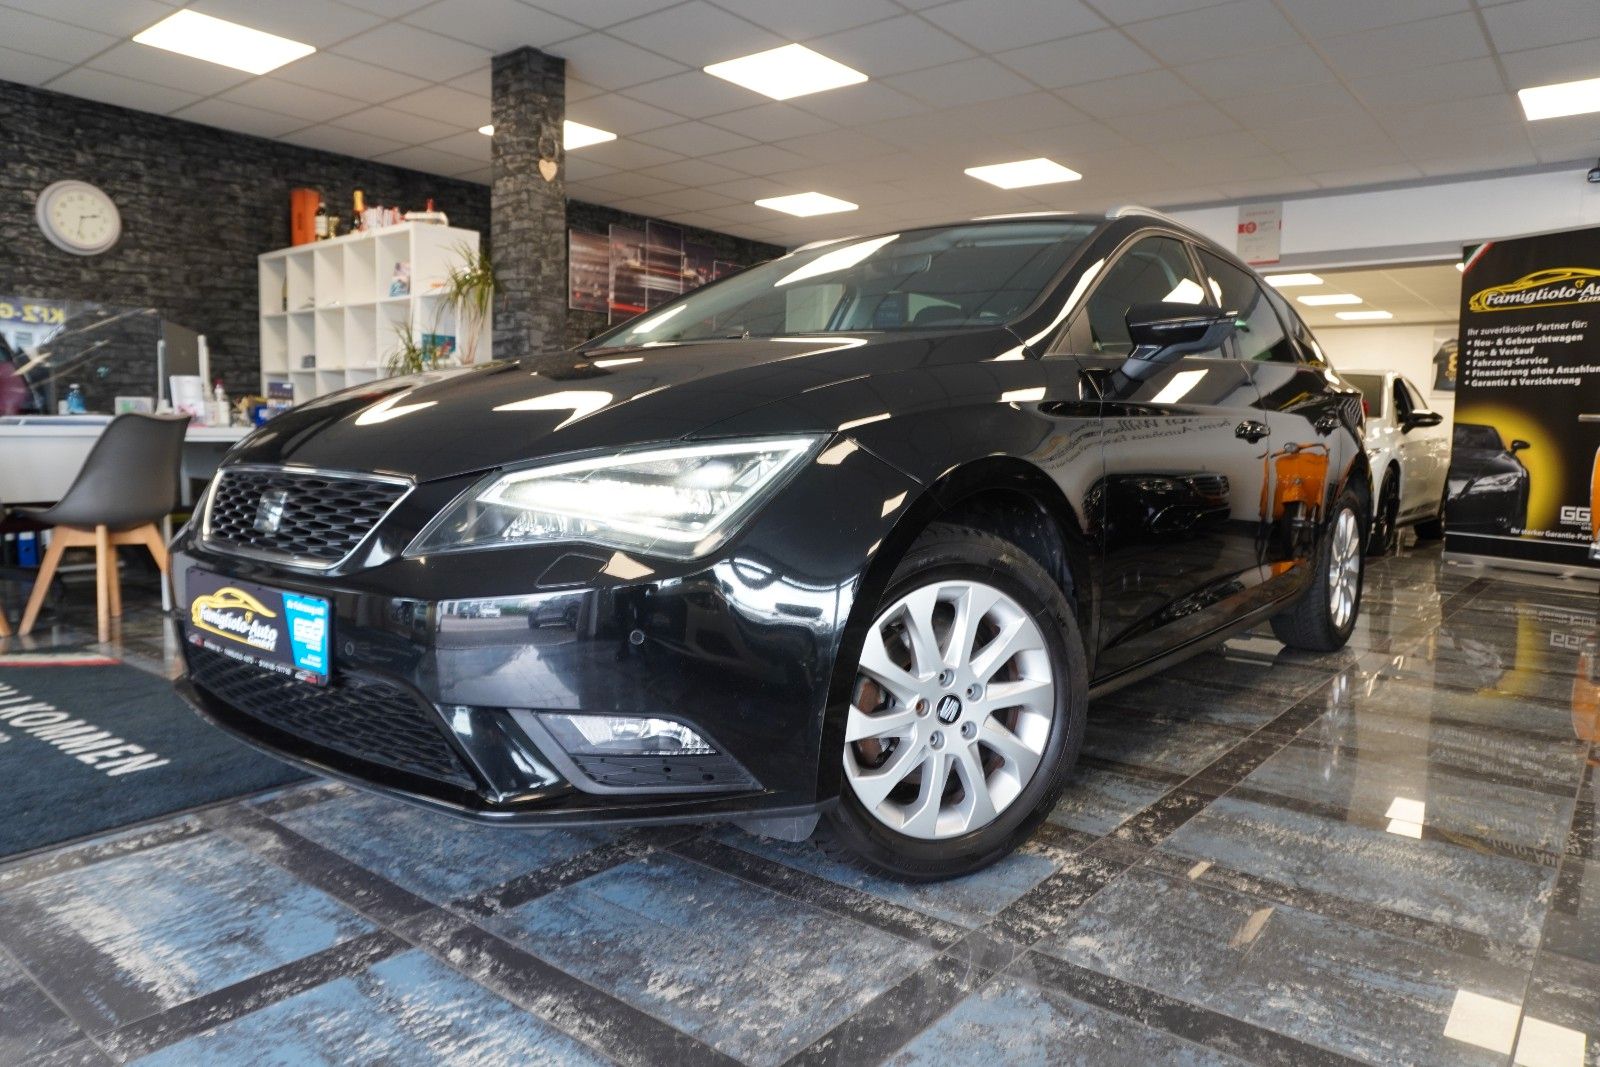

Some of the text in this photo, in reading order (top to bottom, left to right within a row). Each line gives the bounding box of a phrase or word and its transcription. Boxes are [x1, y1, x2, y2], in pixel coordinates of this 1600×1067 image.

[1467, 320, 1588, 336] Ihr zuverlässiger Partner für:
[1505, 334, 1584, 345] Gebrauchtwagen
[1499, 345, 1535, 356] Verkauf
[1472, 357, 1549, 367] Fahrzeug-Service
[1471, 367, 1529, 377] Finanzierung
[1530, 366, 1555, 375] ohne
[1471, 378, 1509, 387] Garantie
[1519, 376, 1581, 386] Versicherung
